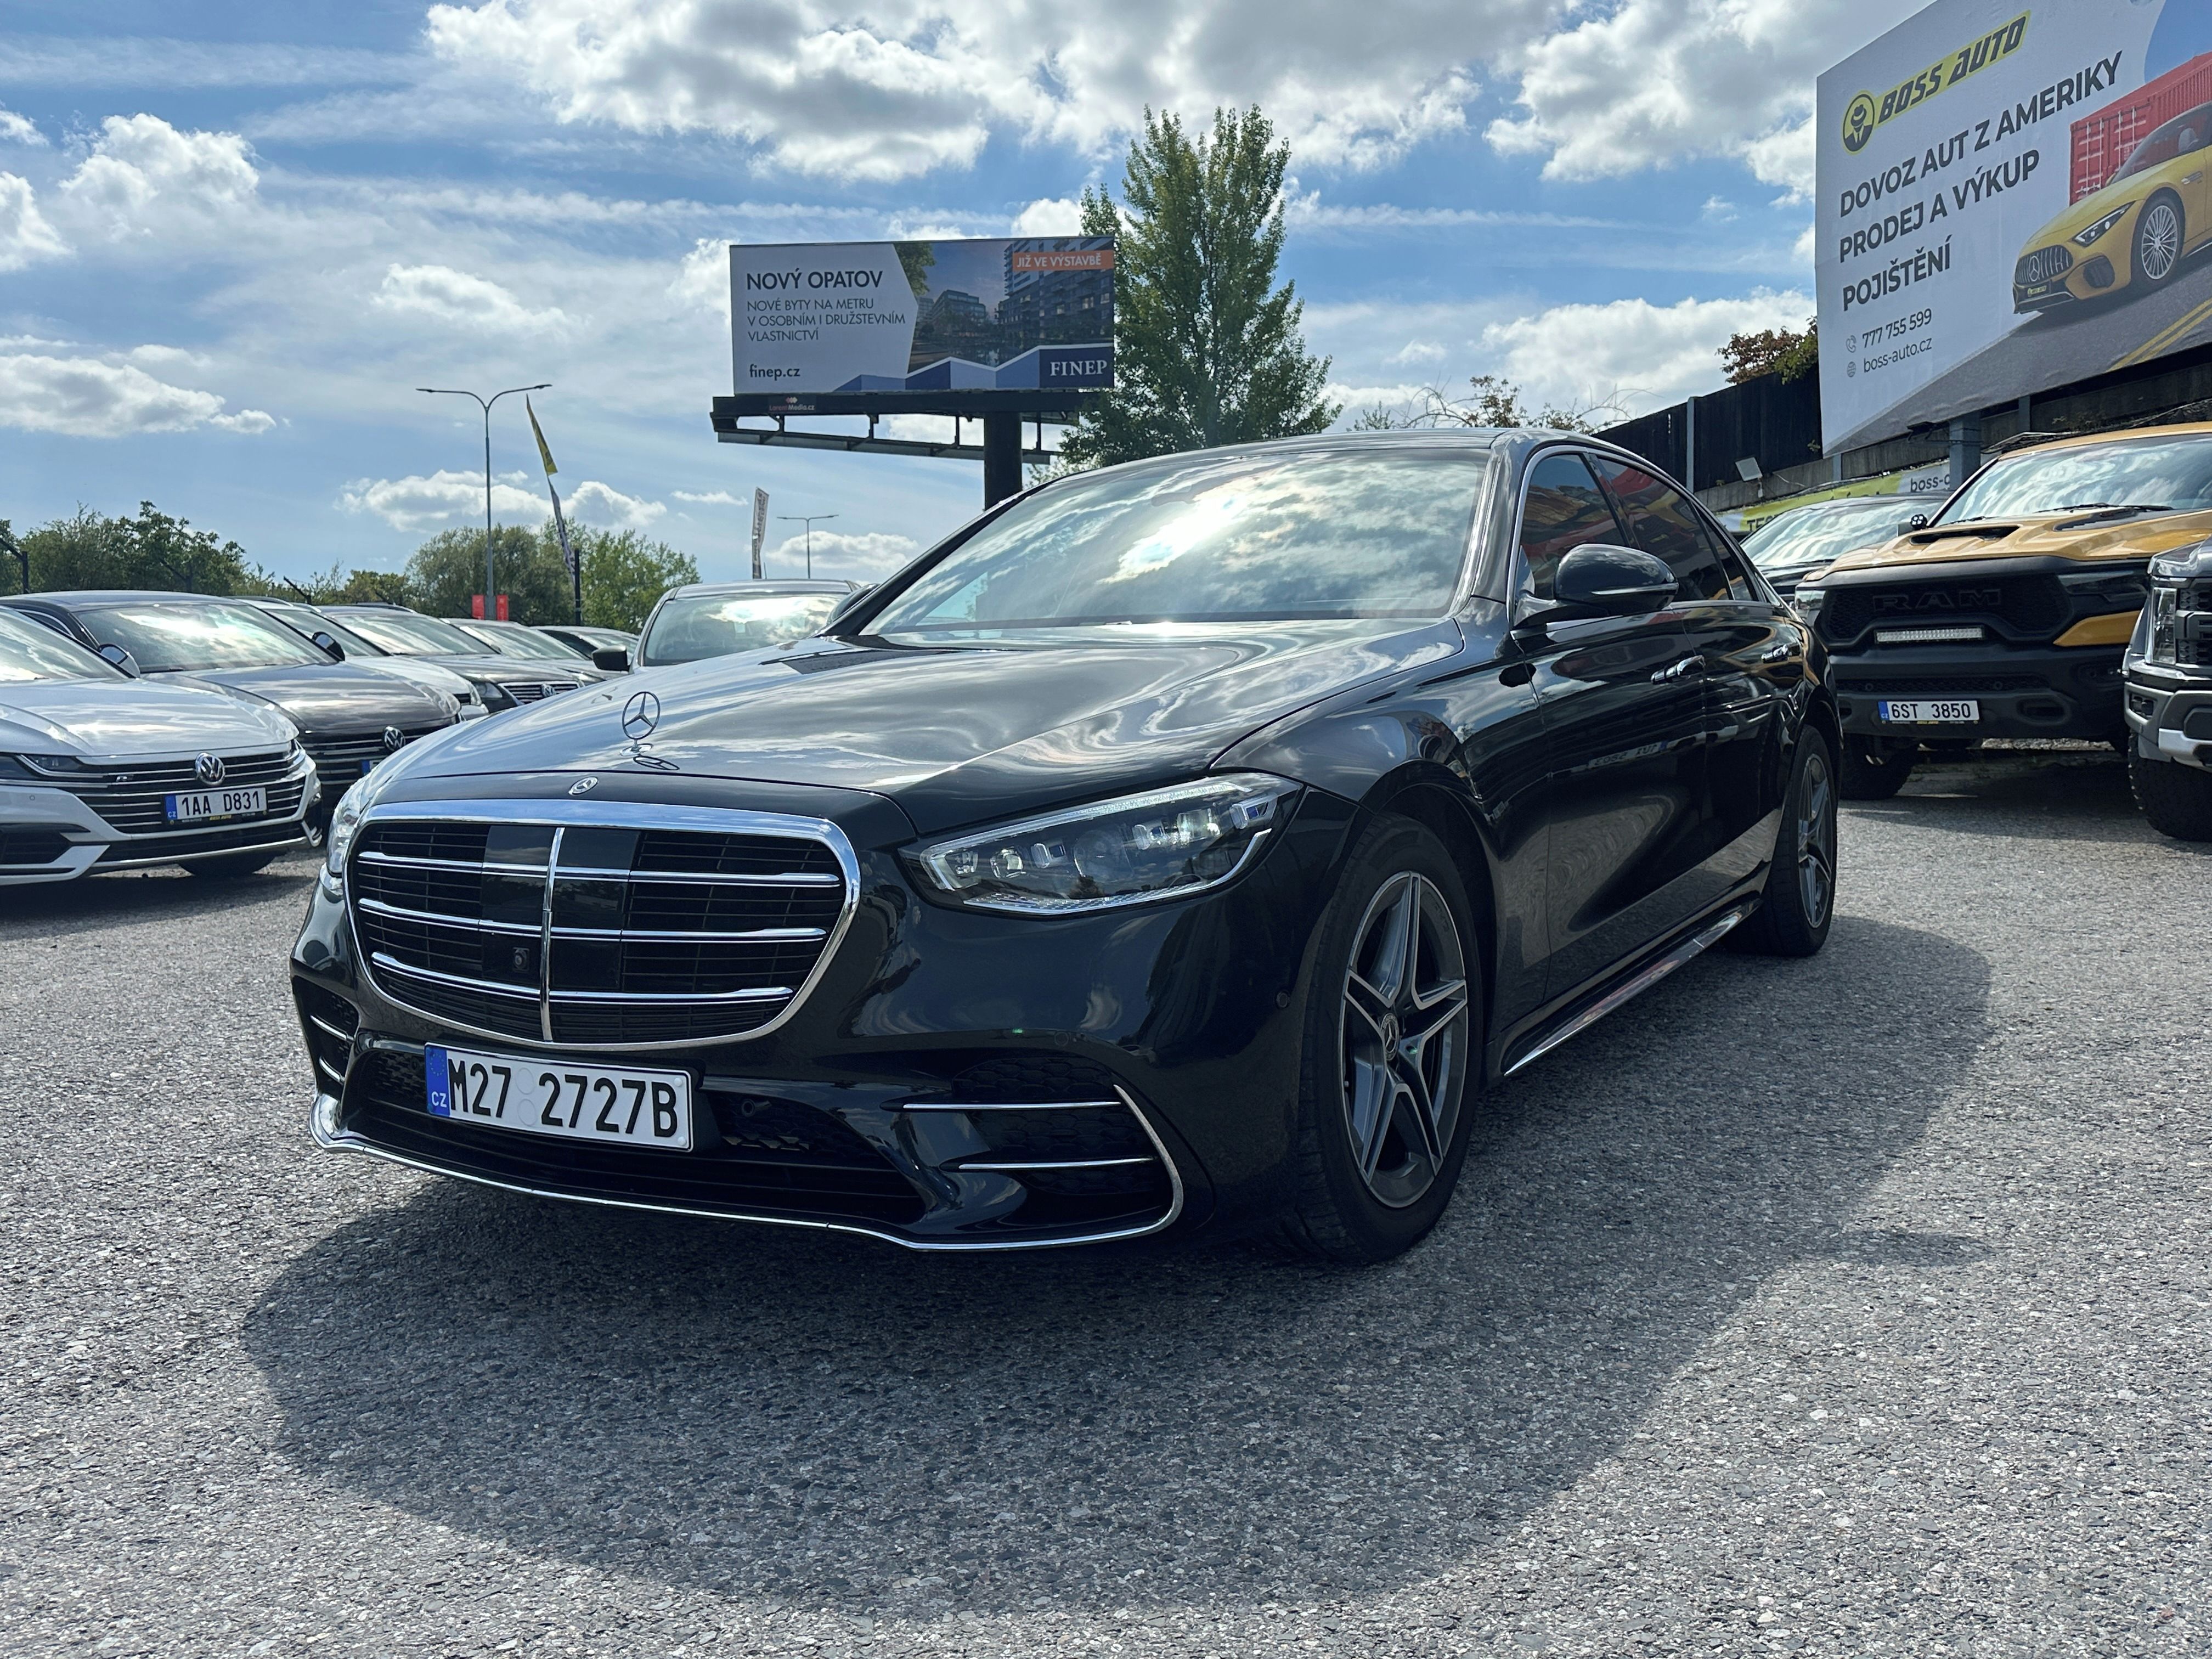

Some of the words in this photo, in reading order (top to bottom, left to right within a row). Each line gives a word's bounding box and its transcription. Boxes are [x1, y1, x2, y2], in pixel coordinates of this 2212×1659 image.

[1877, 63, 1944, 124] BOSS
[1946, 16, 2027, 86] AUTO
[1840, 156, 1916, 218] DOVOZ
[1920, 129, 1969, 179] AUT
[1974, 119, 1990, 152] Z
[1995, 50, 2123, 142] AMERIKY
[1839, 202, 1924, 263] PRODEJ
[1929, 193, 1948, 223] A
[1952, 149, 2039, 210] VÝKUP
[1017, 255, 1031, 268] JIŽ
[1034, 257, 1047, 267] VE
[1050, 253, 1102, 267] VÝSTAVBĚ
[747, 268, 803, 290] NOVÝ
[808, 270, 883, 288] OPATOV
[1843, 234, 1953, 312] POJIŠTĚNÍ
[747, 297, 781, 312] NOVÉ
[785, 300, 811, 311] BYTY
[815, 299, 833, 310] NA
[836, 298, 874, 310] METRU
[747, 315, 756, 326] V
[759, 312, 816, 326] OSOBNÍM
[819, 314, 822, 325] I
[826, 311, 905, 325] DRUŽSTEVNÍM
[1862, 327, 1883, 348] 777
[1886, 318, 1906, 339] 755
[1909, 308, 1932, 330] 599
[748, 328, 819, 341] VLASTNICTVÍ
[1864, 338, 1932, 373] boss-auto.cz
[749, 364, 800, 381] finep.cz
[1050, 360, 1108, 376] FINEP
[1873, 589, 2001, 611] RAM
[1891, 703, 1918, 719] 6ST
[1931, 703, 1971, 719] 3850
[182, 795, 212, 816] 1AA
[223, 791, 259, 812] D831
[431, 1091, 447, 1108] CZ
[447, 1058, 511, 1118] M27
[538, 1072, 678, 1138] 2727B
